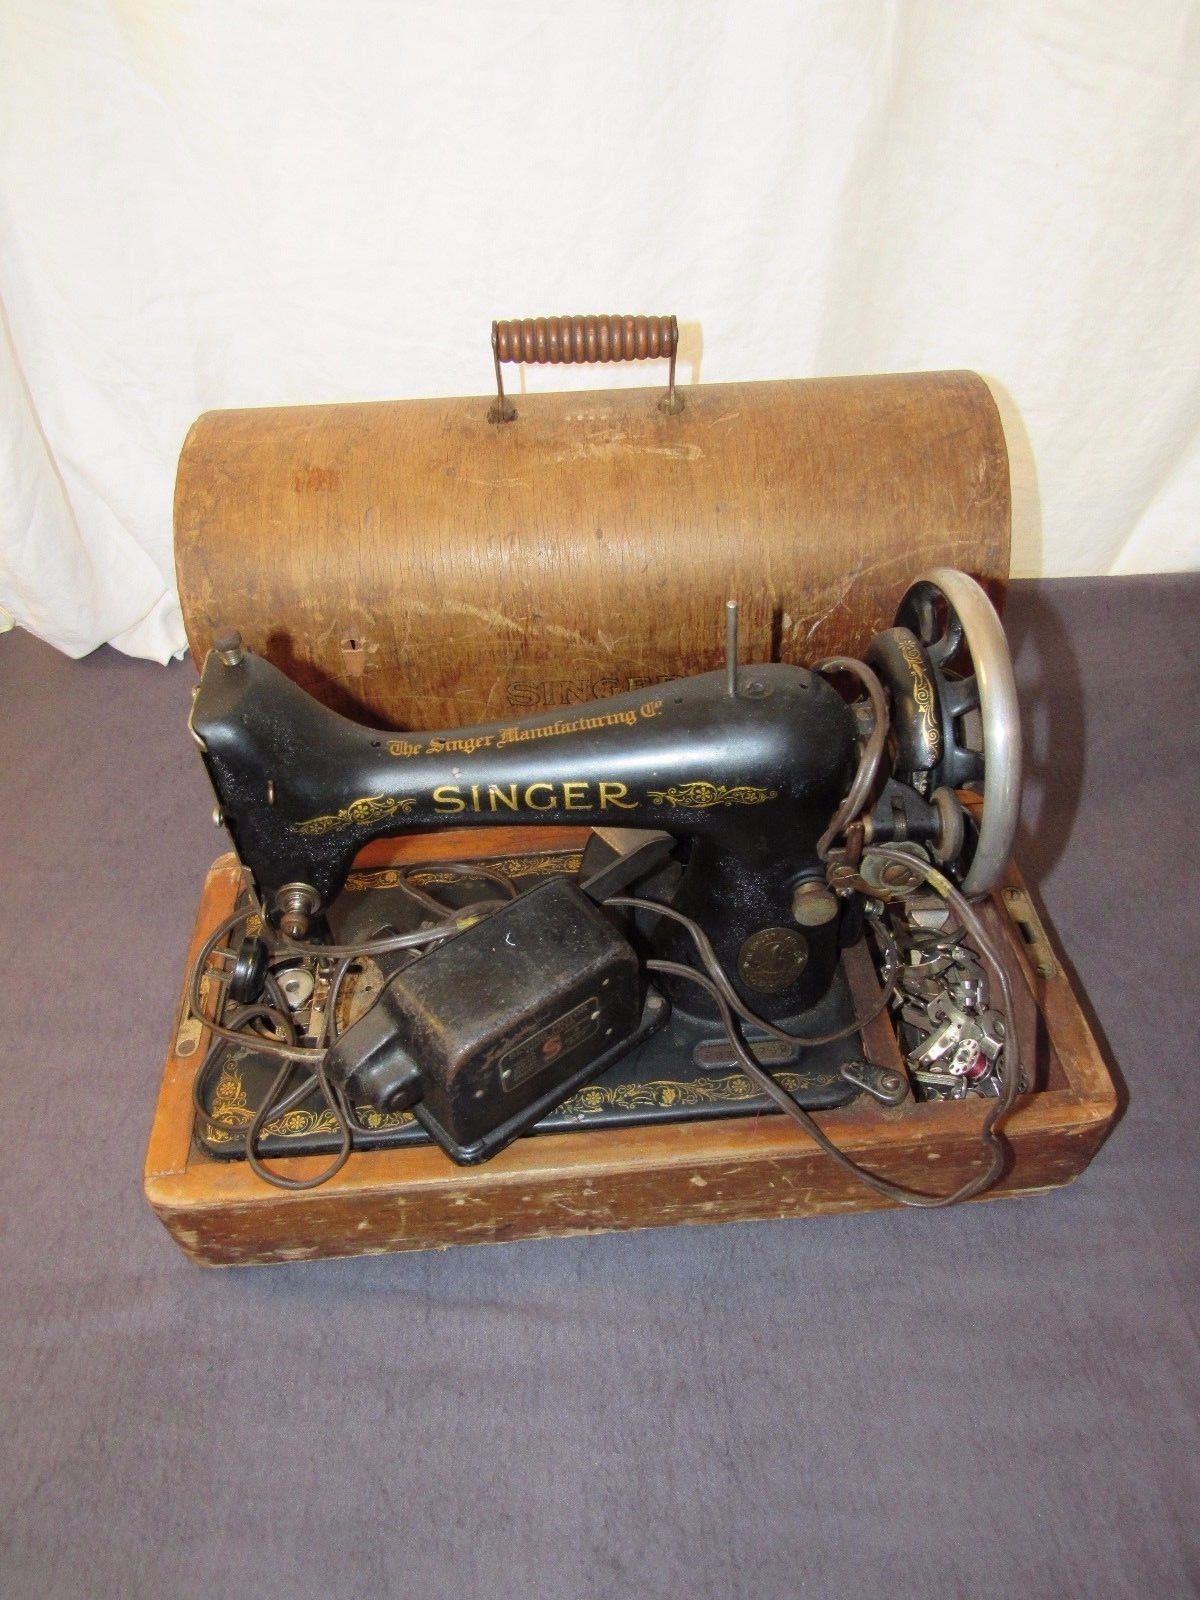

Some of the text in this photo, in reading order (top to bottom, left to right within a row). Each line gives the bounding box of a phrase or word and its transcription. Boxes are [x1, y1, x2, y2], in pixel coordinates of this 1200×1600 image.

[507, 675, 684, 706] SINGE
[388, 740, 422, 757] The
[426, 735, 495, 755] Singer
[497, 710, 638, 749] Manufacturing
[433, 782, 640, 813] SINGER
